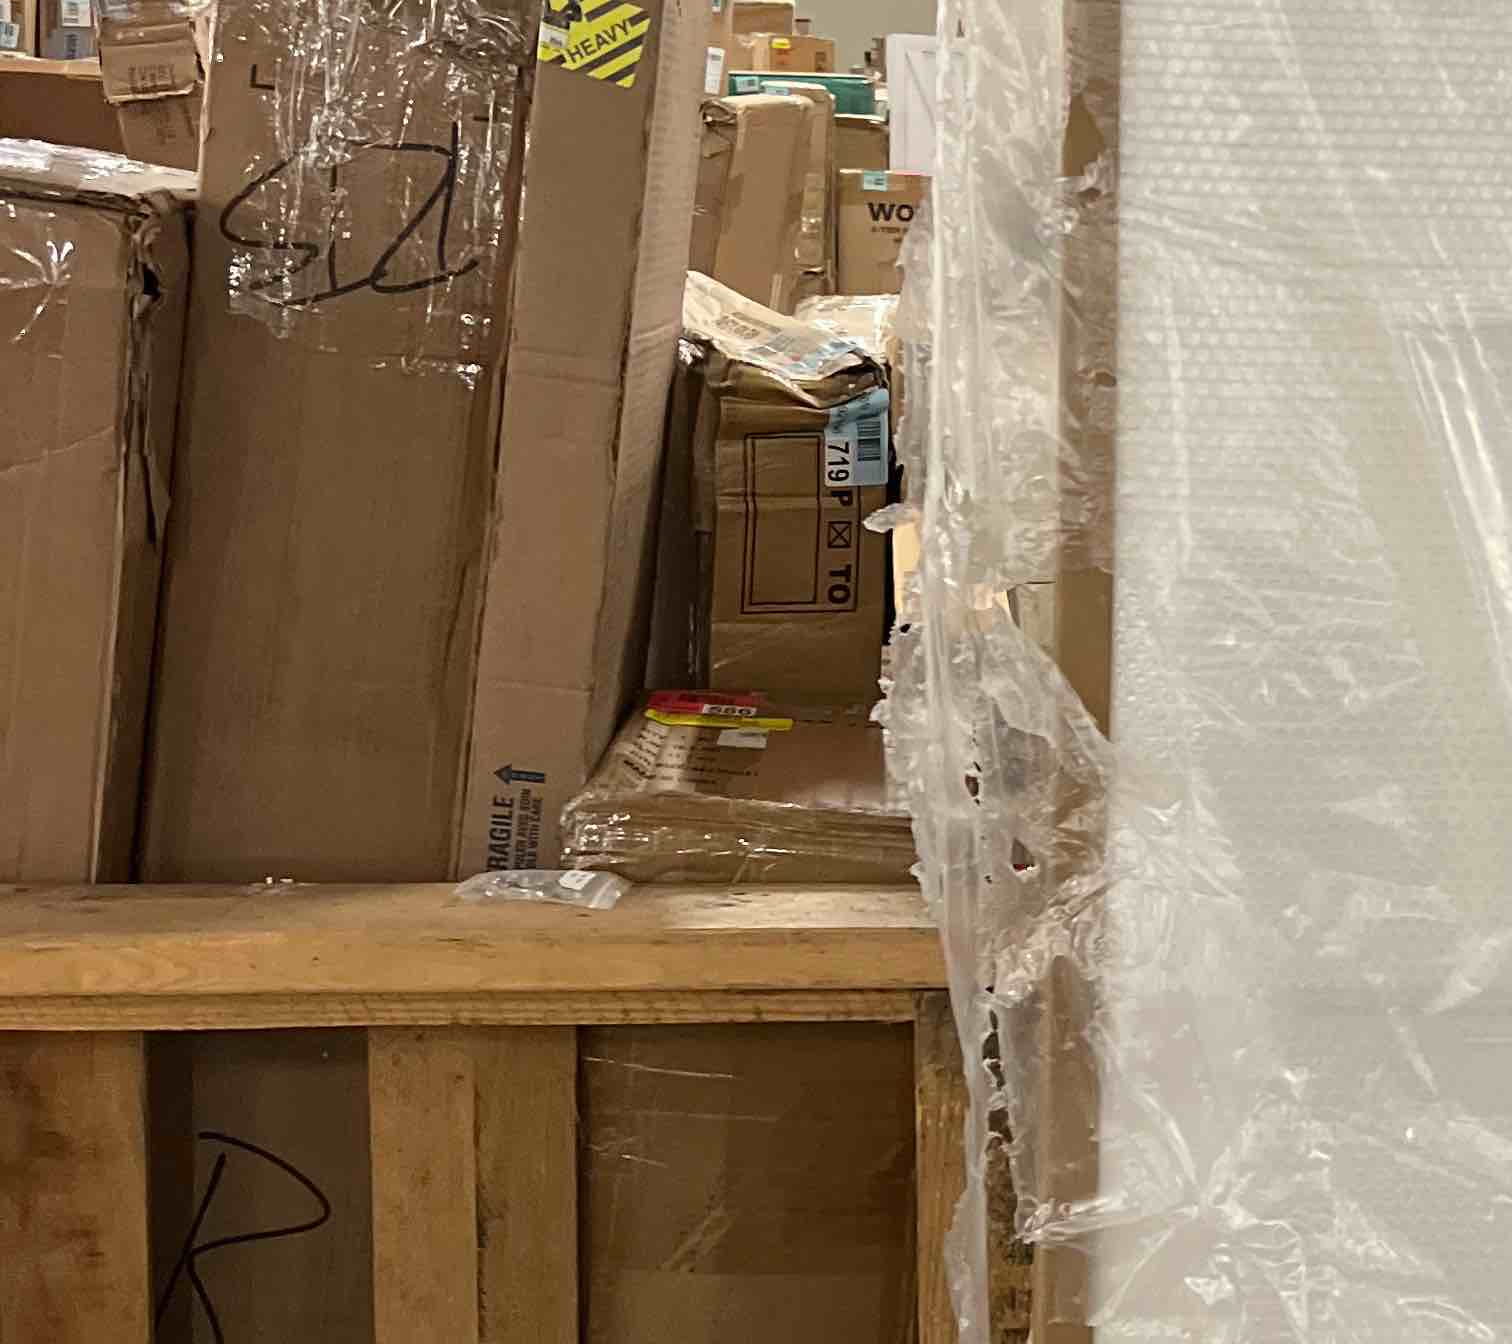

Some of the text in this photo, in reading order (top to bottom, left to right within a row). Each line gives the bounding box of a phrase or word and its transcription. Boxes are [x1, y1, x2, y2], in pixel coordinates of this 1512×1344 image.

[566, 19, 632, 63] HEAVY
[827, 441, 850, 482] 719
[487, 795, 514, 871] RAGILE
